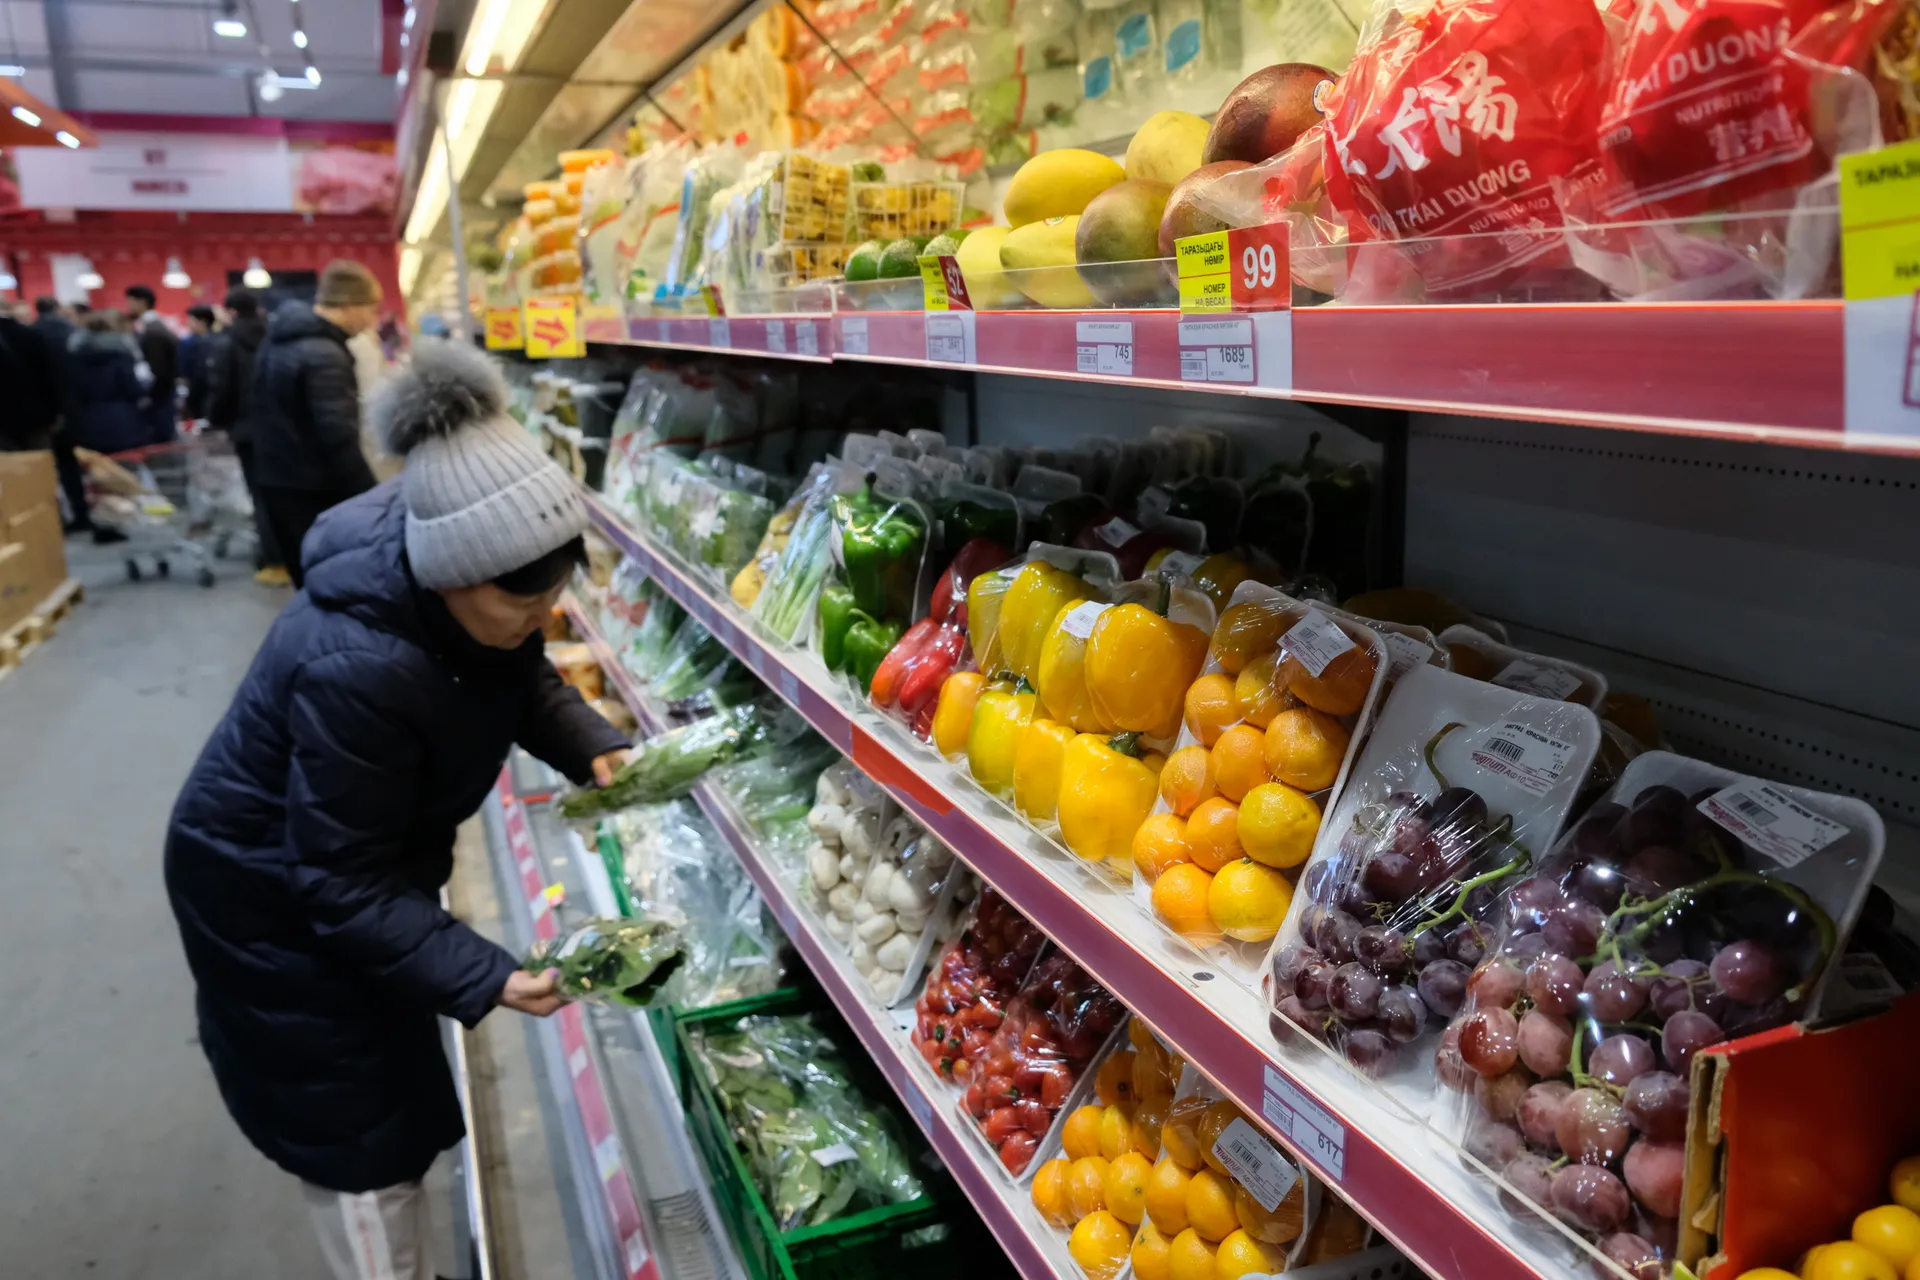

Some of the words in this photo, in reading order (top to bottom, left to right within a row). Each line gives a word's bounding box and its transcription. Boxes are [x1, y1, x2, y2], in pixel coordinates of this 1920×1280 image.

[1396, 197, 1445, 228] THAI
[1443, 159, 1531, 207] DUONG
[1180, 241, 1224, 256] ТАРАЗЫДАҒЫ
[1242, 244, 1276, 289] 99
[1203, 283, 1226, 295] НОМЕР
[1114, 345, 1129, 359] 745
[1220, 347, 1245, 363] 1689
[1318, 1132, 1339, 1160] 617
